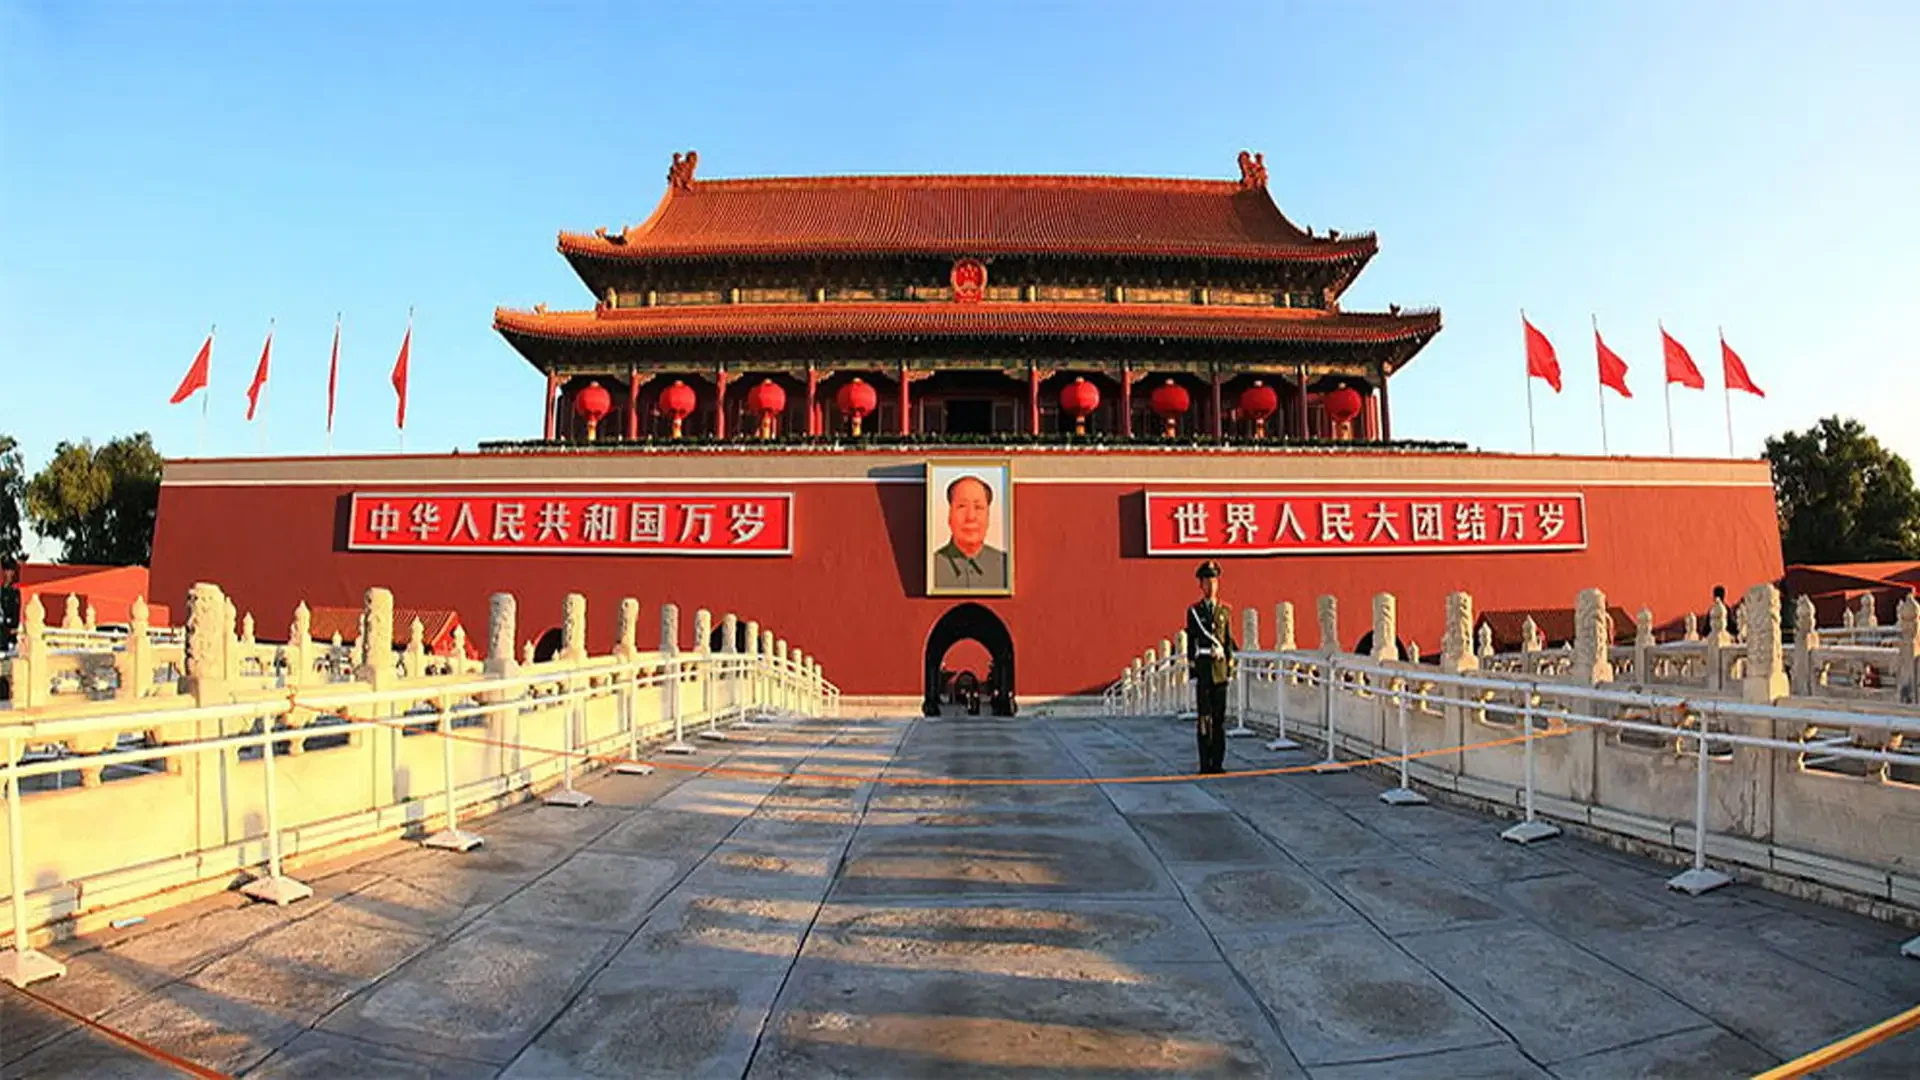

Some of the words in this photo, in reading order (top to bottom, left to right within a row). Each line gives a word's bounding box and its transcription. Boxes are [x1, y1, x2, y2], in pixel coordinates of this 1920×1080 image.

[369, 501, 765, 544] 中华人民共和国万岁
[1174, 502, 1565, 544] 世界人民大团结万岁
